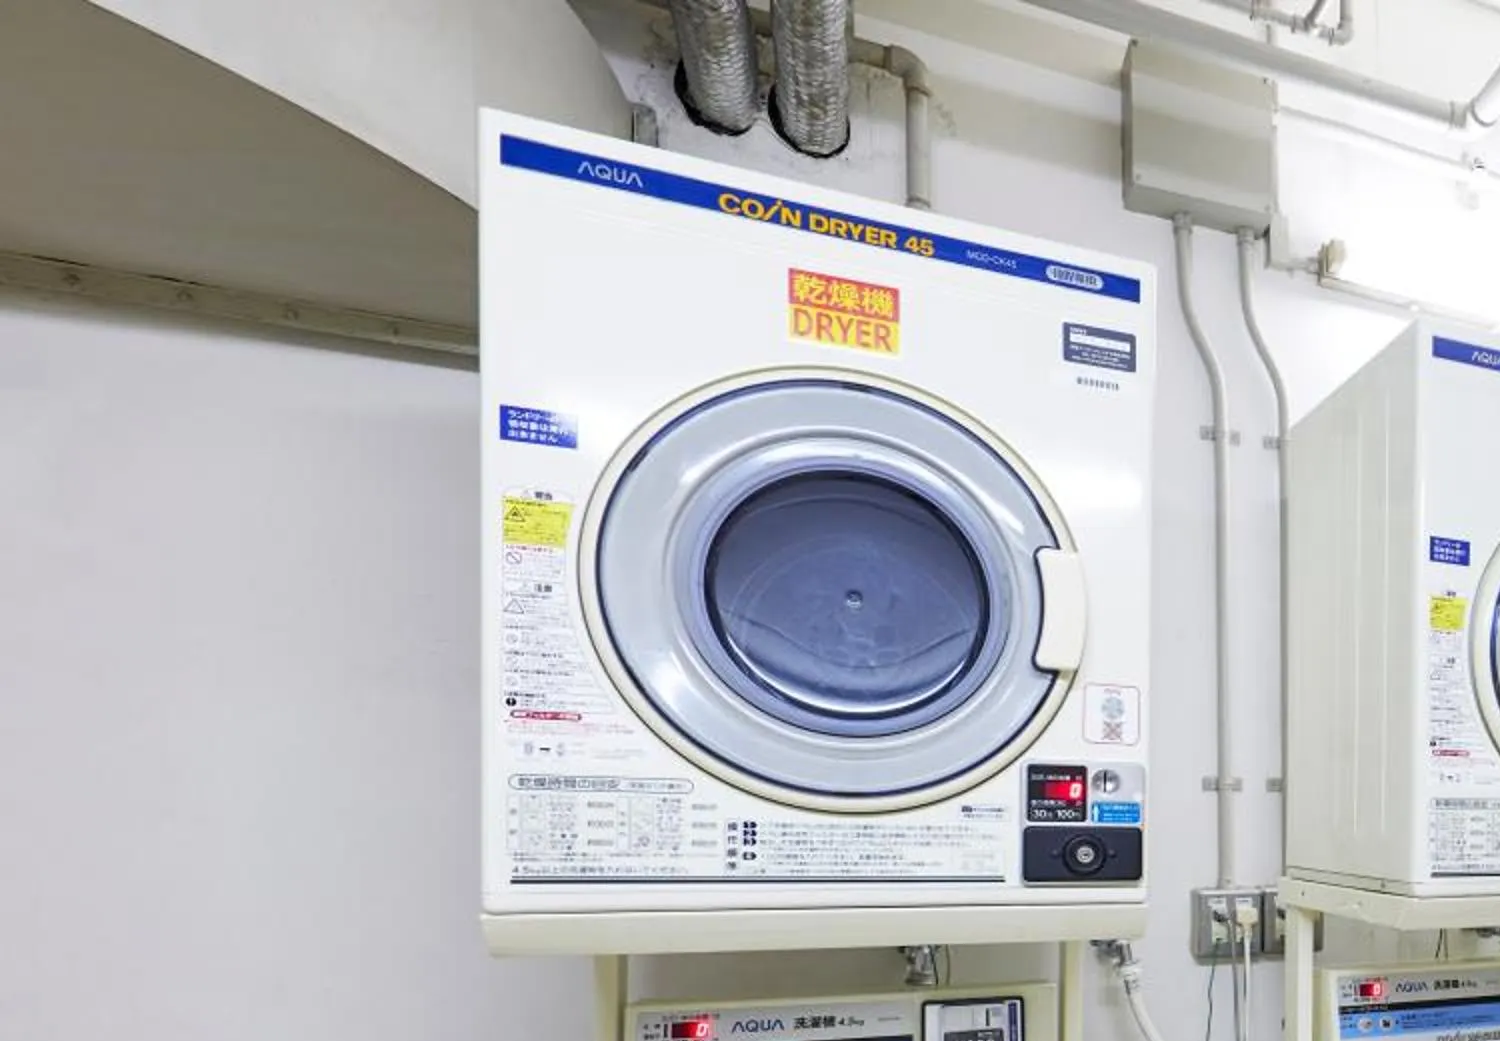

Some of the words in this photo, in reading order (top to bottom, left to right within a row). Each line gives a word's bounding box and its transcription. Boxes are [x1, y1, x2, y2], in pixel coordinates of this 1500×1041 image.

[578, 161, 644, 188] AQUA
[808, 212, 898, 249] DRYER
[904, 235, 936, 257] 45
[792, 273, 895, 318] 乾燥機
[792, 307, 894, 352] DRYER
[731, 1019, 785, 1034] AQUA
